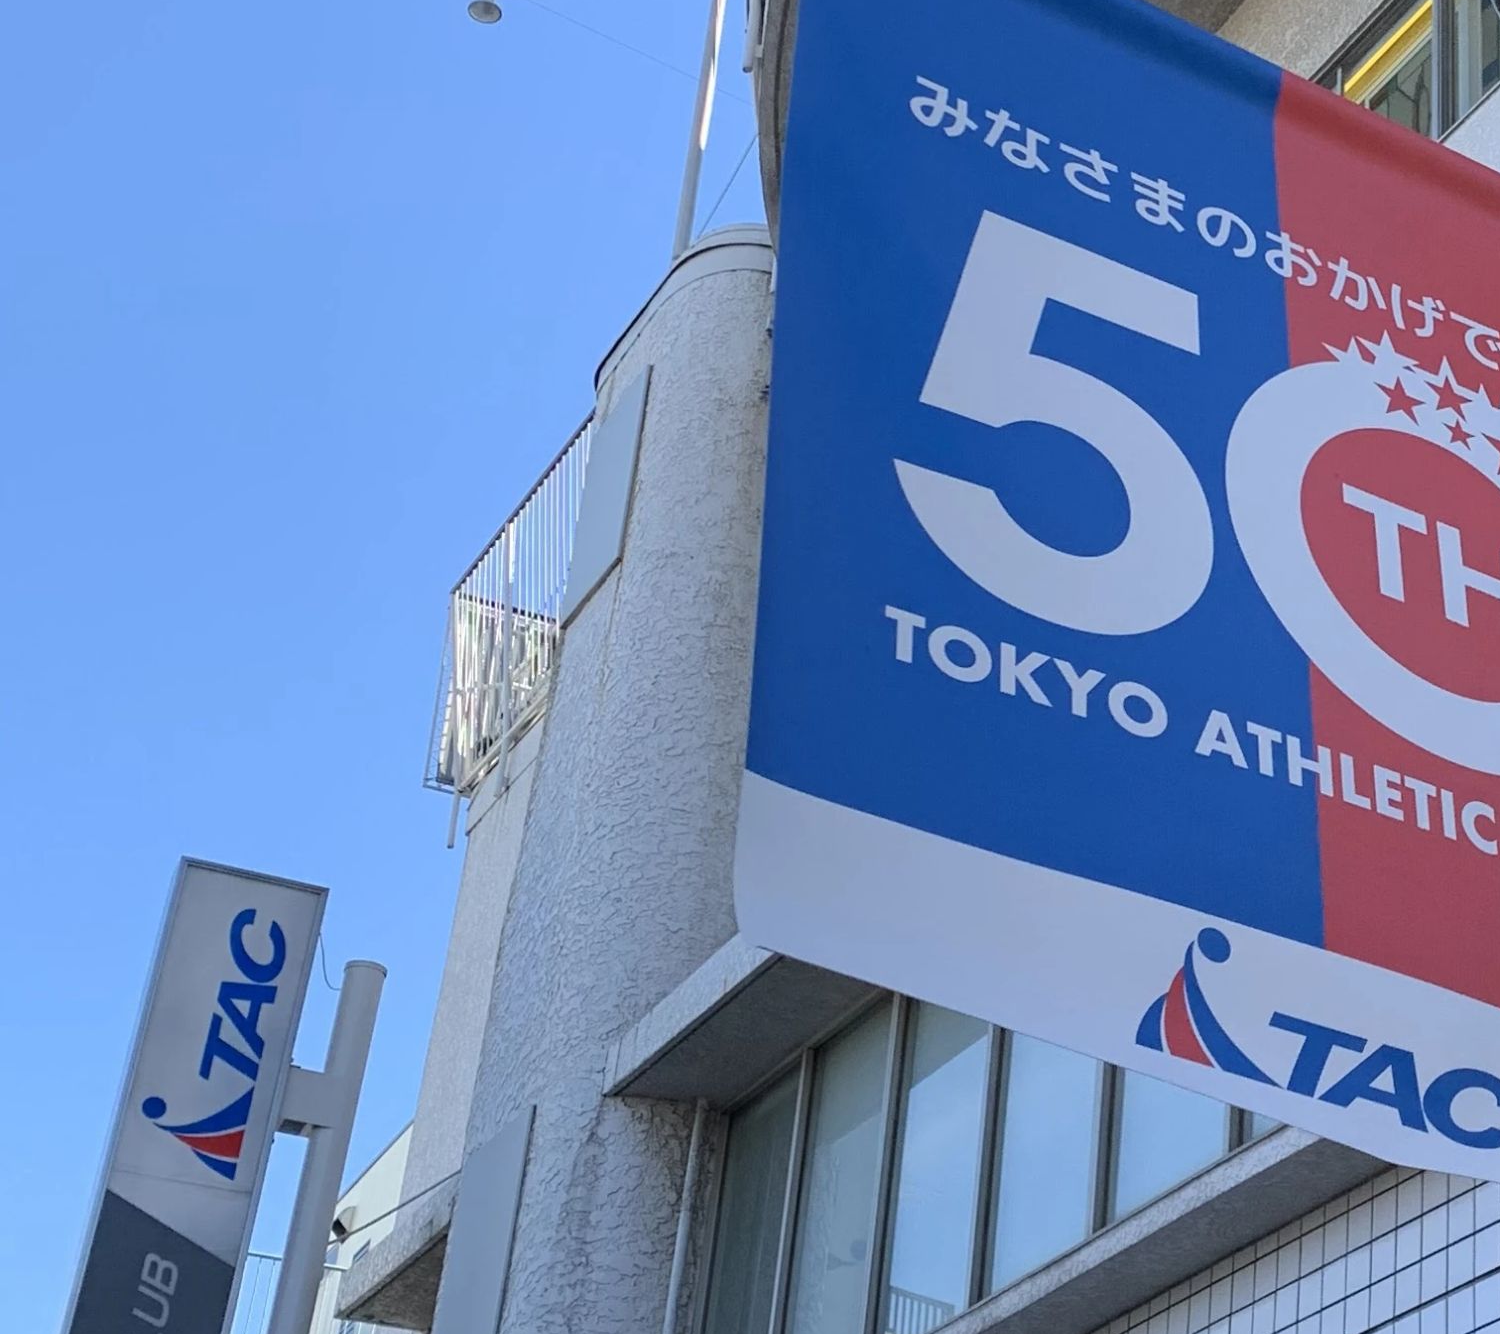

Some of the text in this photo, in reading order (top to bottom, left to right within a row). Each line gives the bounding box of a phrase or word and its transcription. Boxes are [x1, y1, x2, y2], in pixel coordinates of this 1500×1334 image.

[884, 606, 1169, 740] TOKYO
[1194, 709, 1497, 856] ATHLETIC
[200, 908, 287, 1082] TAC
